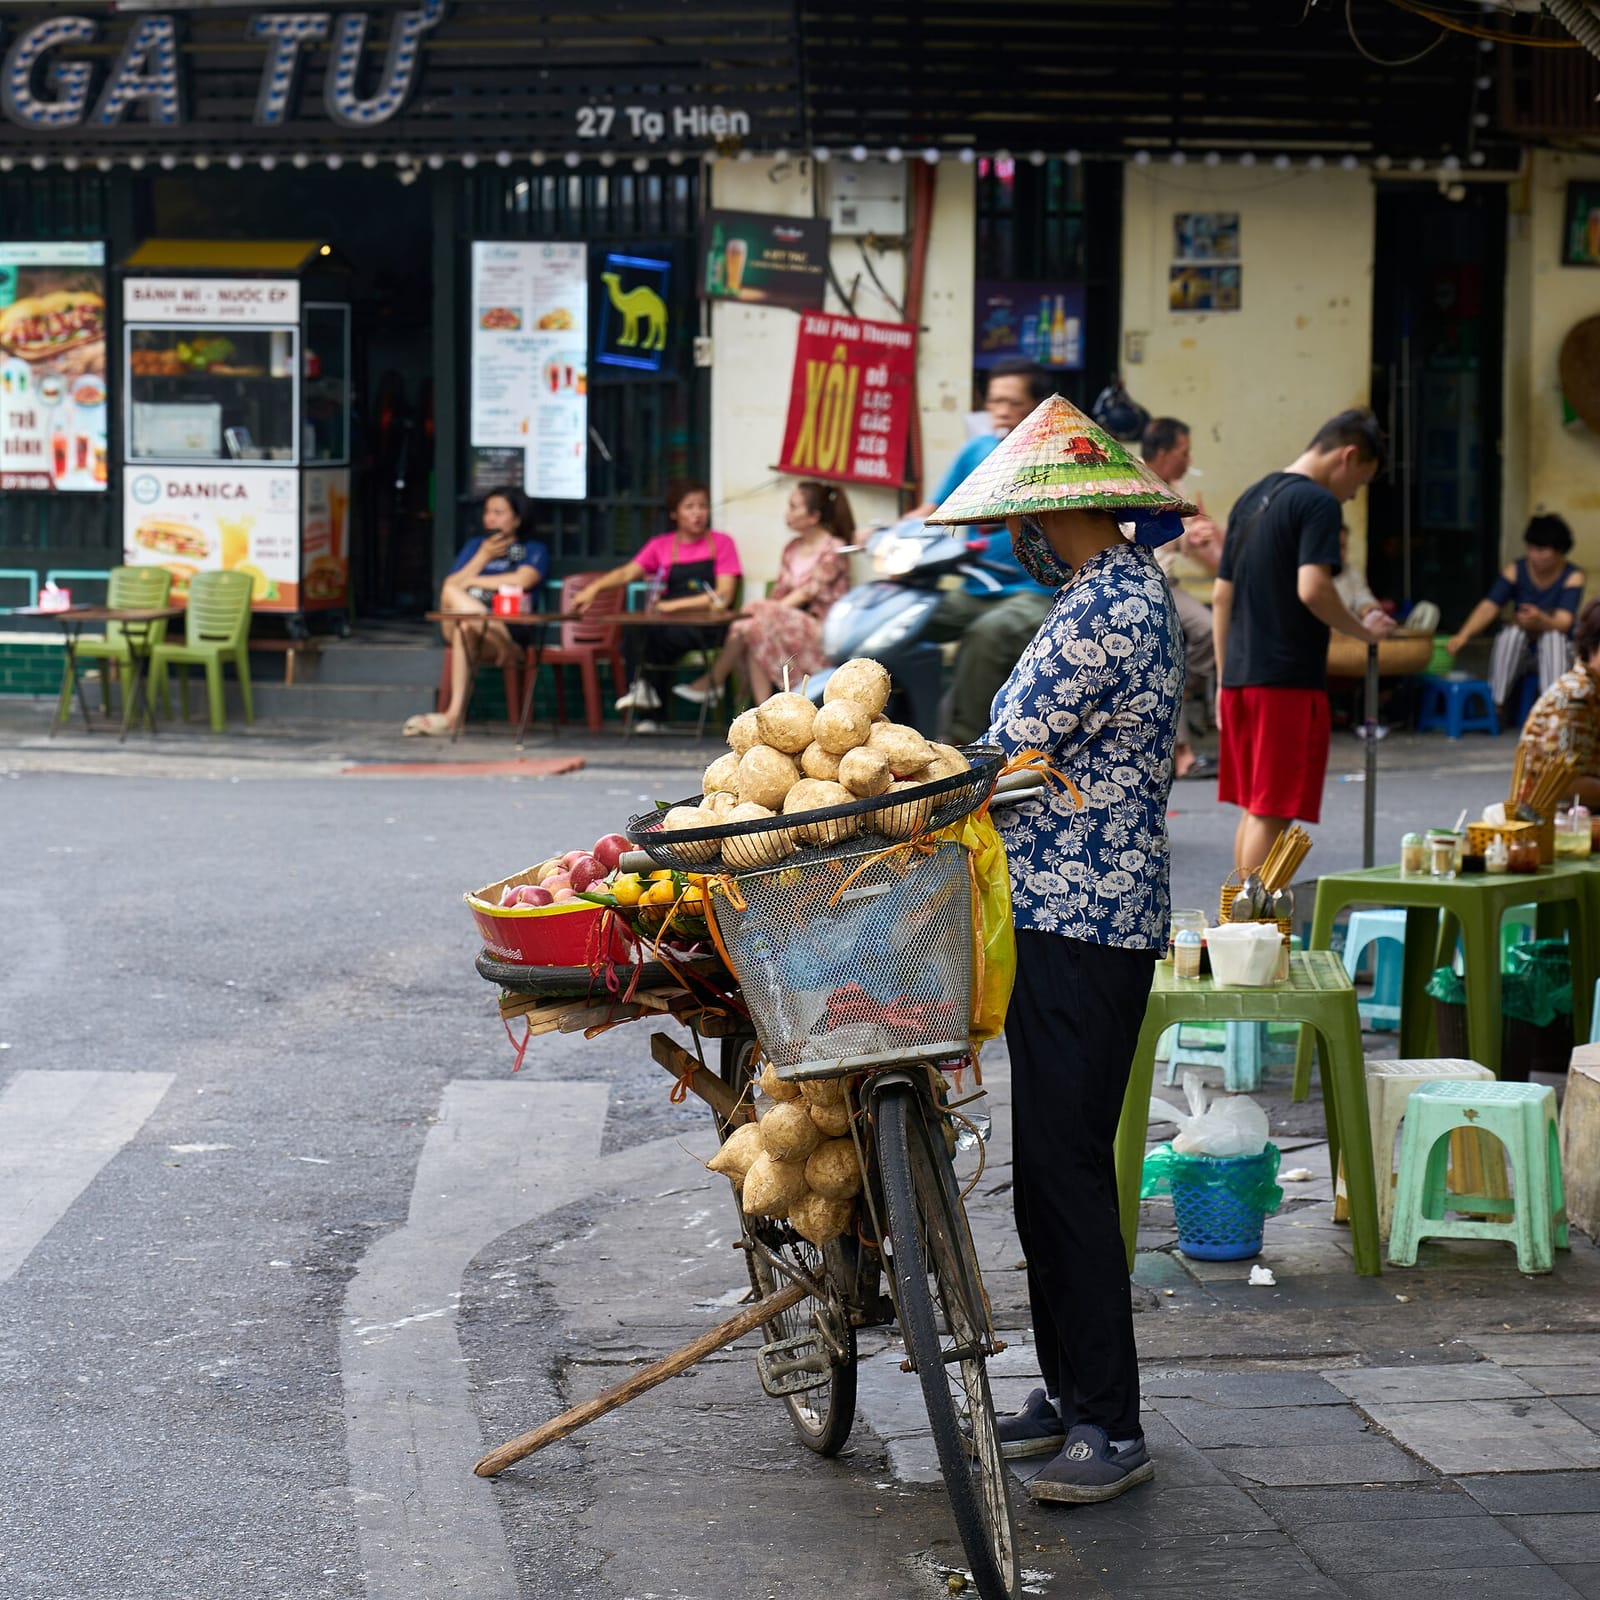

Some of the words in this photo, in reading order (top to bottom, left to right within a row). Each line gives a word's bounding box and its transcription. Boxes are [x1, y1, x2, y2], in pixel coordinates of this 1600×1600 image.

[576, 106, 616, 138] 27
[625, 106, 666, 143] Tạ
[673, 105, 750, 143] Hiện
[791, 343, 860, 473] XÔI
[167, 482, 249, 499] DANICA
